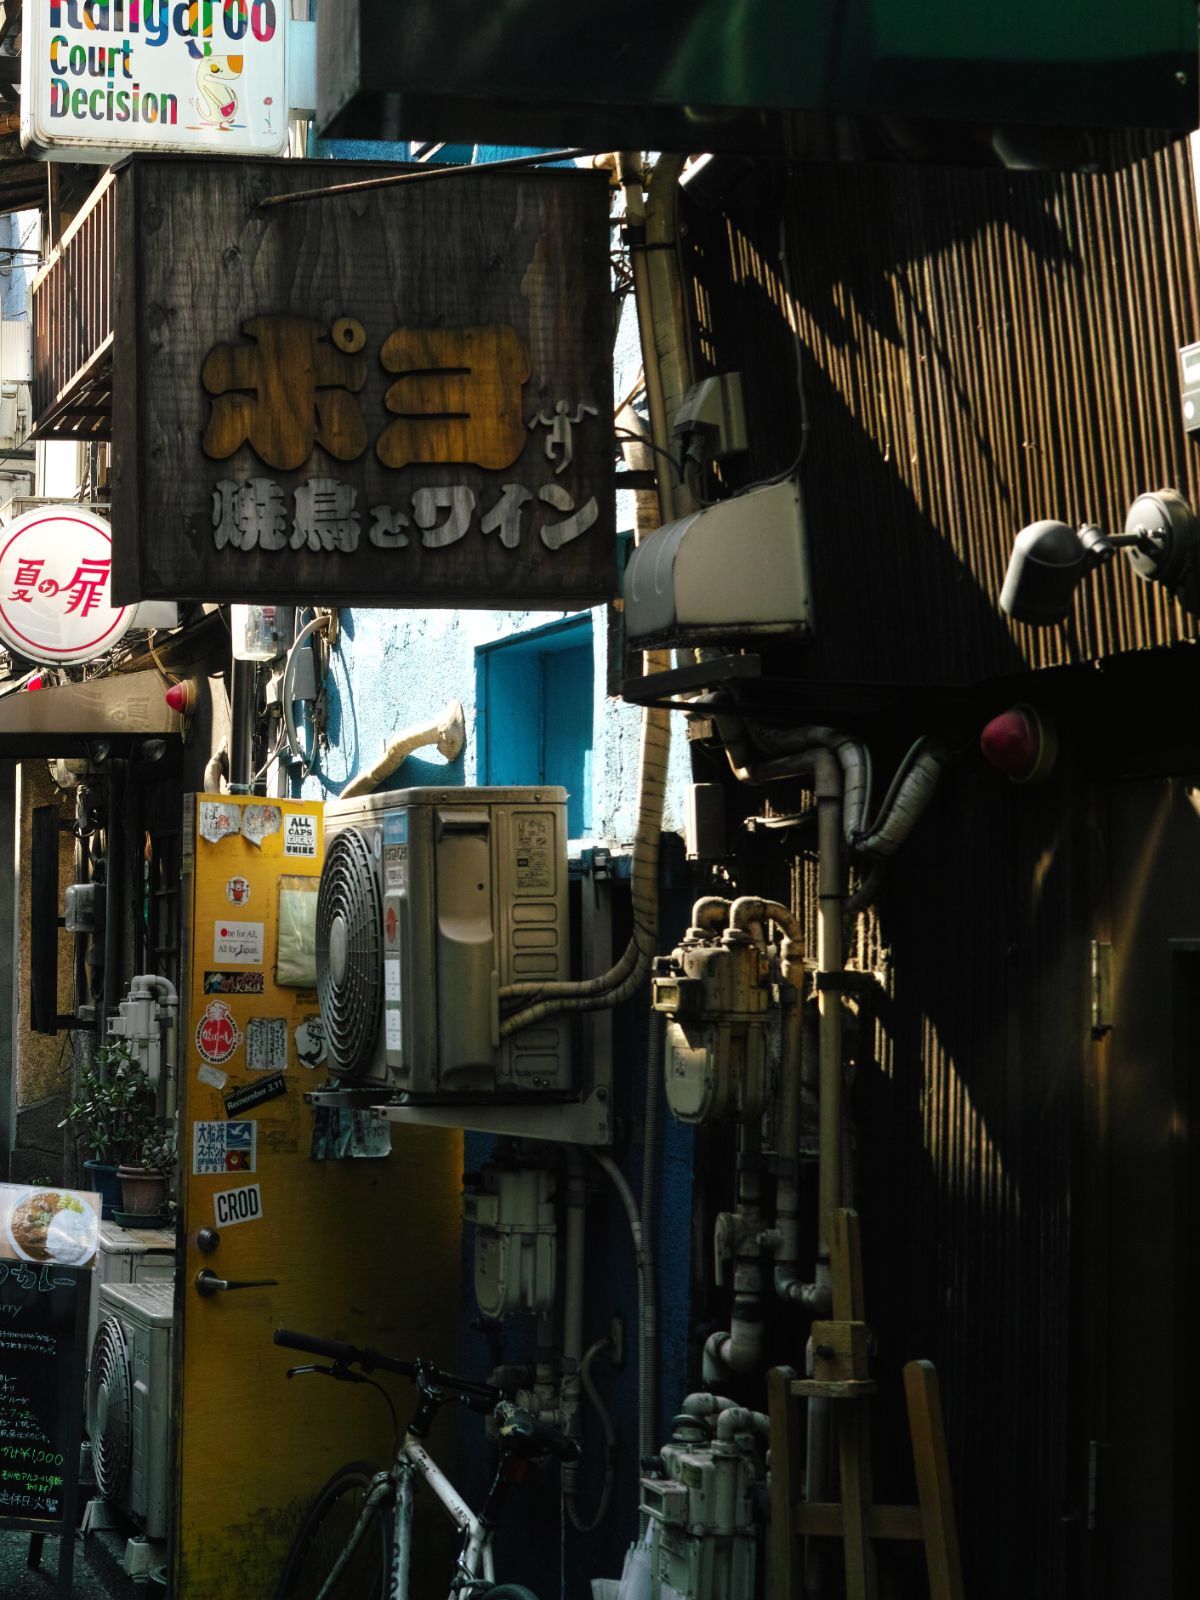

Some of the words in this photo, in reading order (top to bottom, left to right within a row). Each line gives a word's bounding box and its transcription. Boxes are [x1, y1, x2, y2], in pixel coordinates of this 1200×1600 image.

[50, 35, 133, 78] Court
[50, 78, 177, 124] Decision
[202, 313, 531, 471] ポヨ
[212, 476, 600, 553] 焼鳥とワイン
[7, 557, 112, 618] 夏の扉
[288, 828, 312, 836] CAPS
[291, 817, 311, 828] ALL
[227, 1087, 268, 1111] Remember
[267, 1079, 284, 1094] 3.11
[197, 1143, 225, 1157] スポット
[198, 1123, 225, 1143] 大船渡
[197, 1157, 225, 1166] OFUNATO
[217, 1187, 259, 1223] CROD
